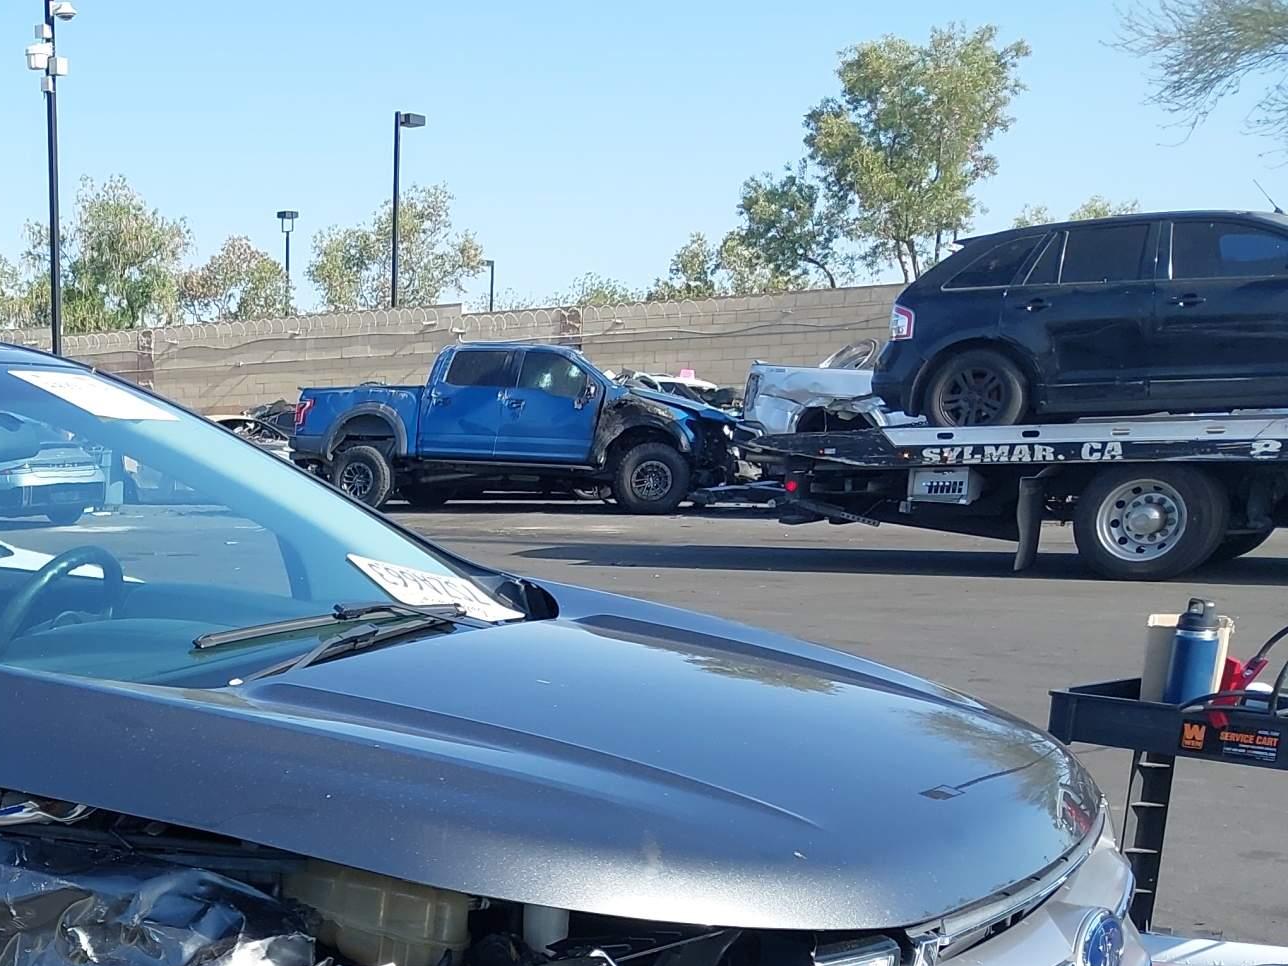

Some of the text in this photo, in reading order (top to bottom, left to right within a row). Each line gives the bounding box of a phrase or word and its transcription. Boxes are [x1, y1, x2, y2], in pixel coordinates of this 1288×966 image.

[1080, 441, 1124, 461] CA
[1219, 731, 1256, 744] SERVICE
[1256, 736, 1279, 747] CART
